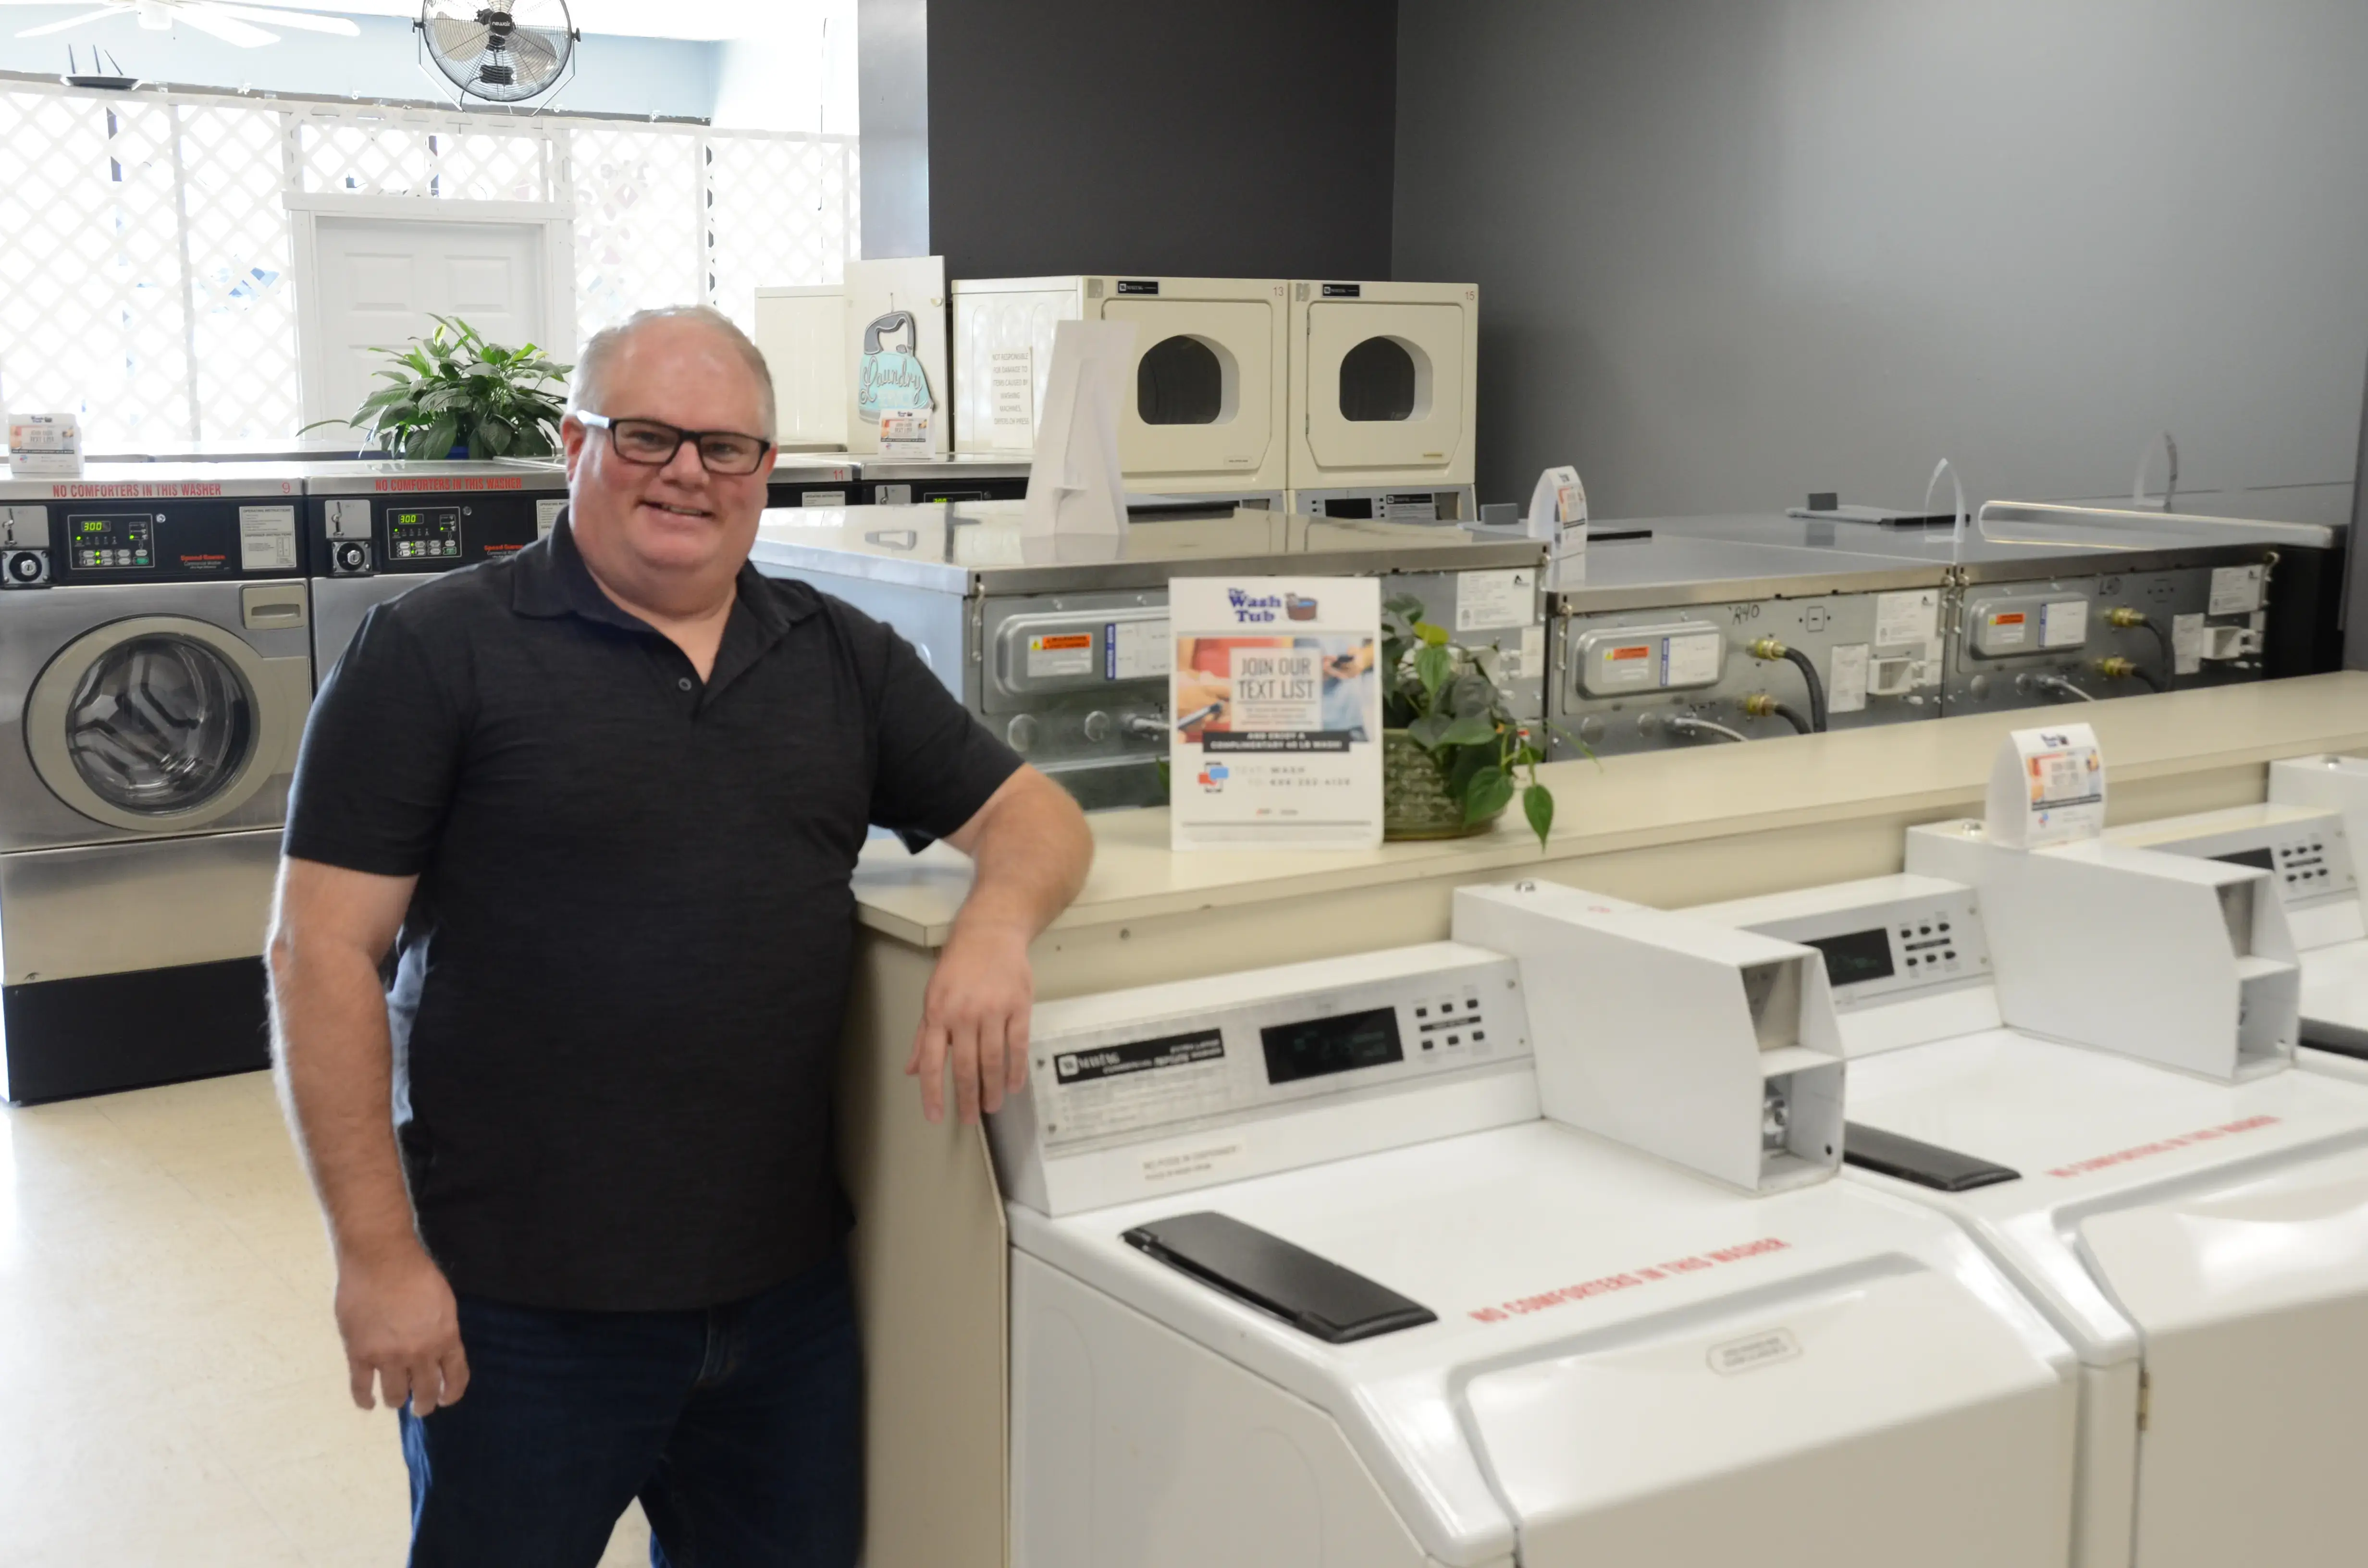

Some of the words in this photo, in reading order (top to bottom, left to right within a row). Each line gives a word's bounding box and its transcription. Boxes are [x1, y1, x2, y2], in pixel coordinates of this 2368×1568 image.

[1273, 286, 1283, 296] 13
[1465, 291, 1475, 301] 15
[860, 355, 922, 404] Laundry
[833, 469, 843, 480] 11
[53, 485, 67, 497] NO
[71, 484, 139, 497] COMFORTERS
[143, 484, 152, 496] IN
[156, 483, 178, 496] THIS
[181, 483, 222, 496] WASHER
[282, 482, 291, 494] 9
[375, 479, 387, 491] NO
[391, 478, 450, 490] COMFORTERS
[453, 478, 461, 490] IN
[465, 478, 483, 490] THIS
[486, 478, 522, 489] WASHER
[400, 514, 416, 523] 300
[84, 522, 102, 531] 300
[1229, 595, 1282, 608] Wash
[1235, 609, 1275, 622] Tub
[1241, 657, 1273, 676] JOIN
[1278, 657, 1312, 675] OUR
[1237, 679, 1276, 699] TEXT
[1281, 679, 1315, 699] LIST
[1210, 740, 1284, 749] COMPLIMENTARY
[1467, 1306, 1509, 1323] NO
[1502, 1273, 1643, 1315] COMFORTERS
[1633, 1266, 1667, 1281] IN
[1657, 1256, 1714, 1274] THIS
[1704, 1237, 1792, 1263] WASHER
